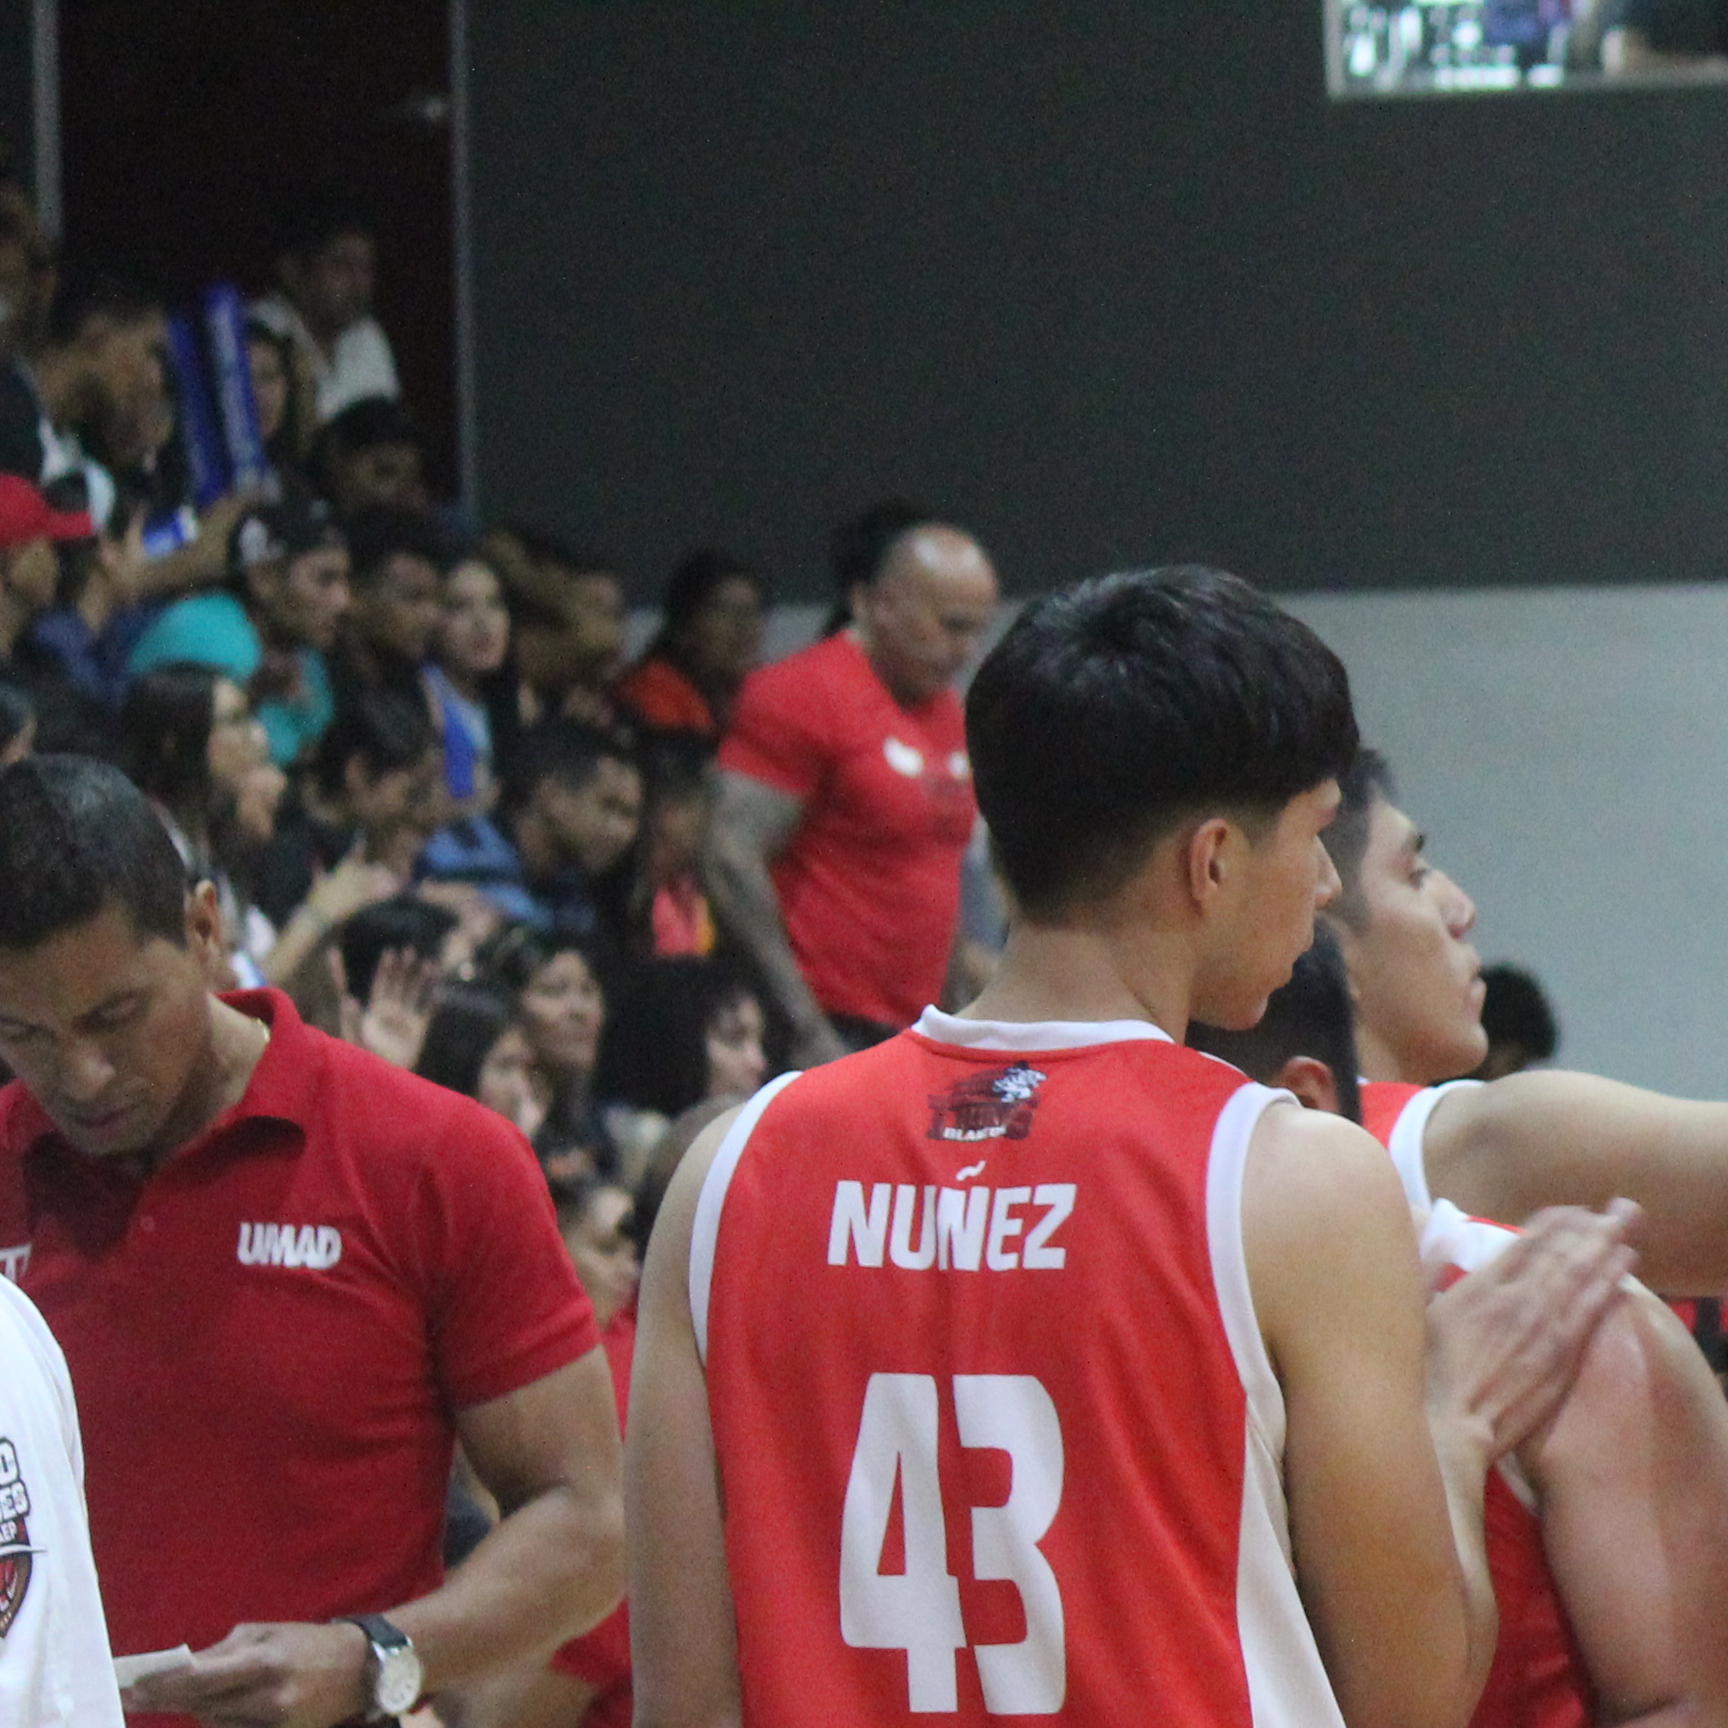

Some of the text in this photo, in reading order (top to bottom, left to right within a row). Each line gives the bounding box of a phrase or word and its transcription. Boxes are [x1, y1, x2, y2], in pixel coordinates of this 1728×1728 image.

[238, 1222, 342, 1269] UMAD
[827, 1160, 1077, 1272] NUÑEZ
[839, 1372, 1066, 1716] 43
